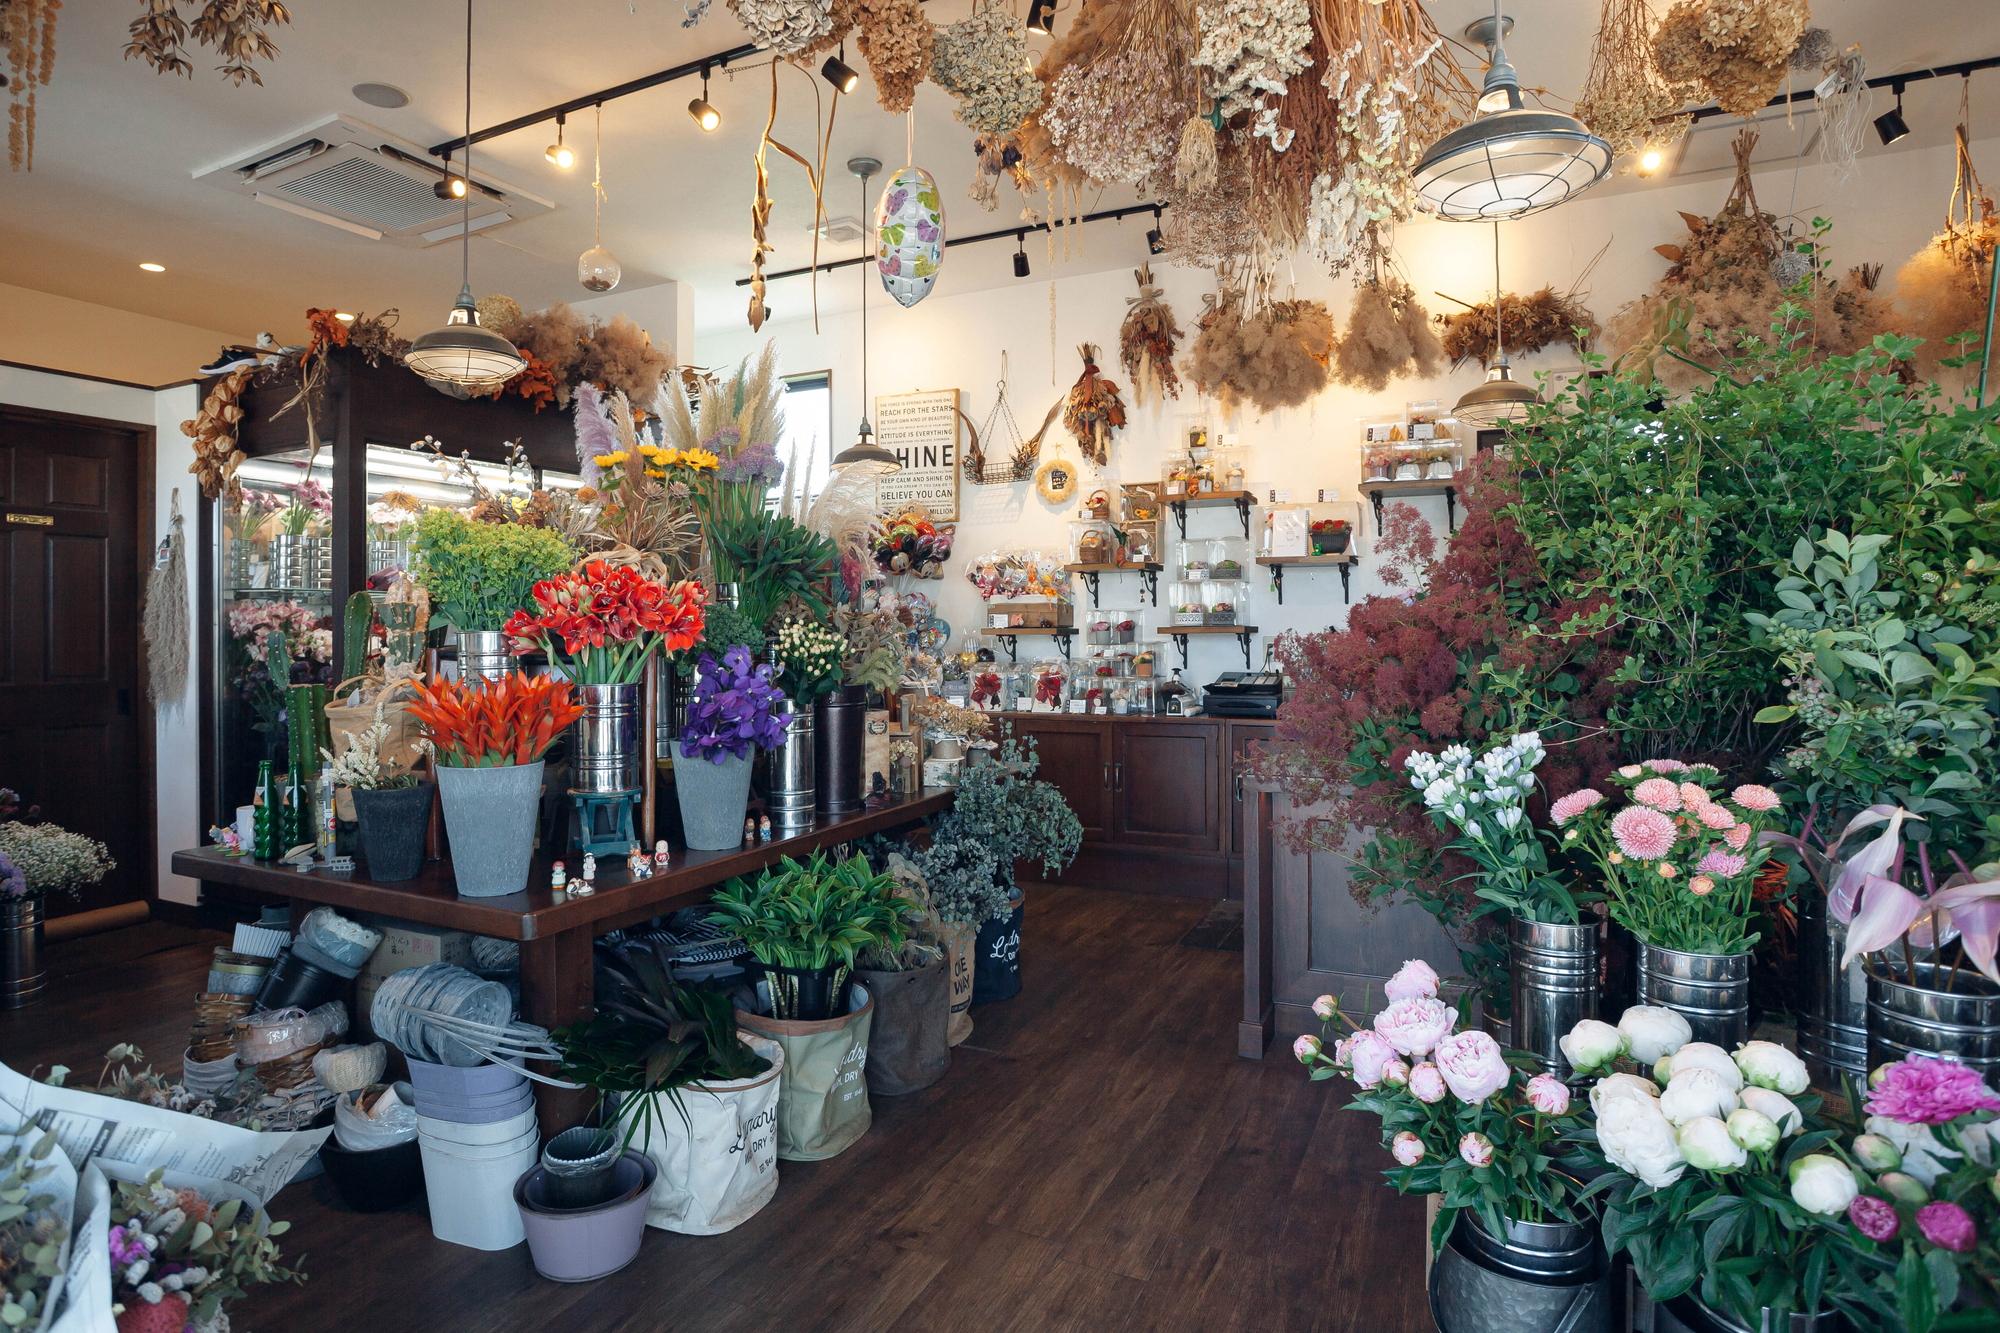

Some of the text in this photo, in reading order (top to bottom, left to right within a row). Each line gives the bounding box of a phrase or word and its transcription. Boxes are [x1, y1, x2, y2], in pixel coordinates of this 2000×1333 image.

[931, 404, 953, 412] STARS
[916, 429, 953, 437] EVERYTHING
[896, 445, 954, 468] HINE
[881, 489, 953, 500] BELIEVE YOU CAN
[954, 957, 968, 977] OE
[953, 974, 970, 995] WAY
[844, 1070, 858, 1083] DRY
[752, 1136, 767, 1152] DRY
